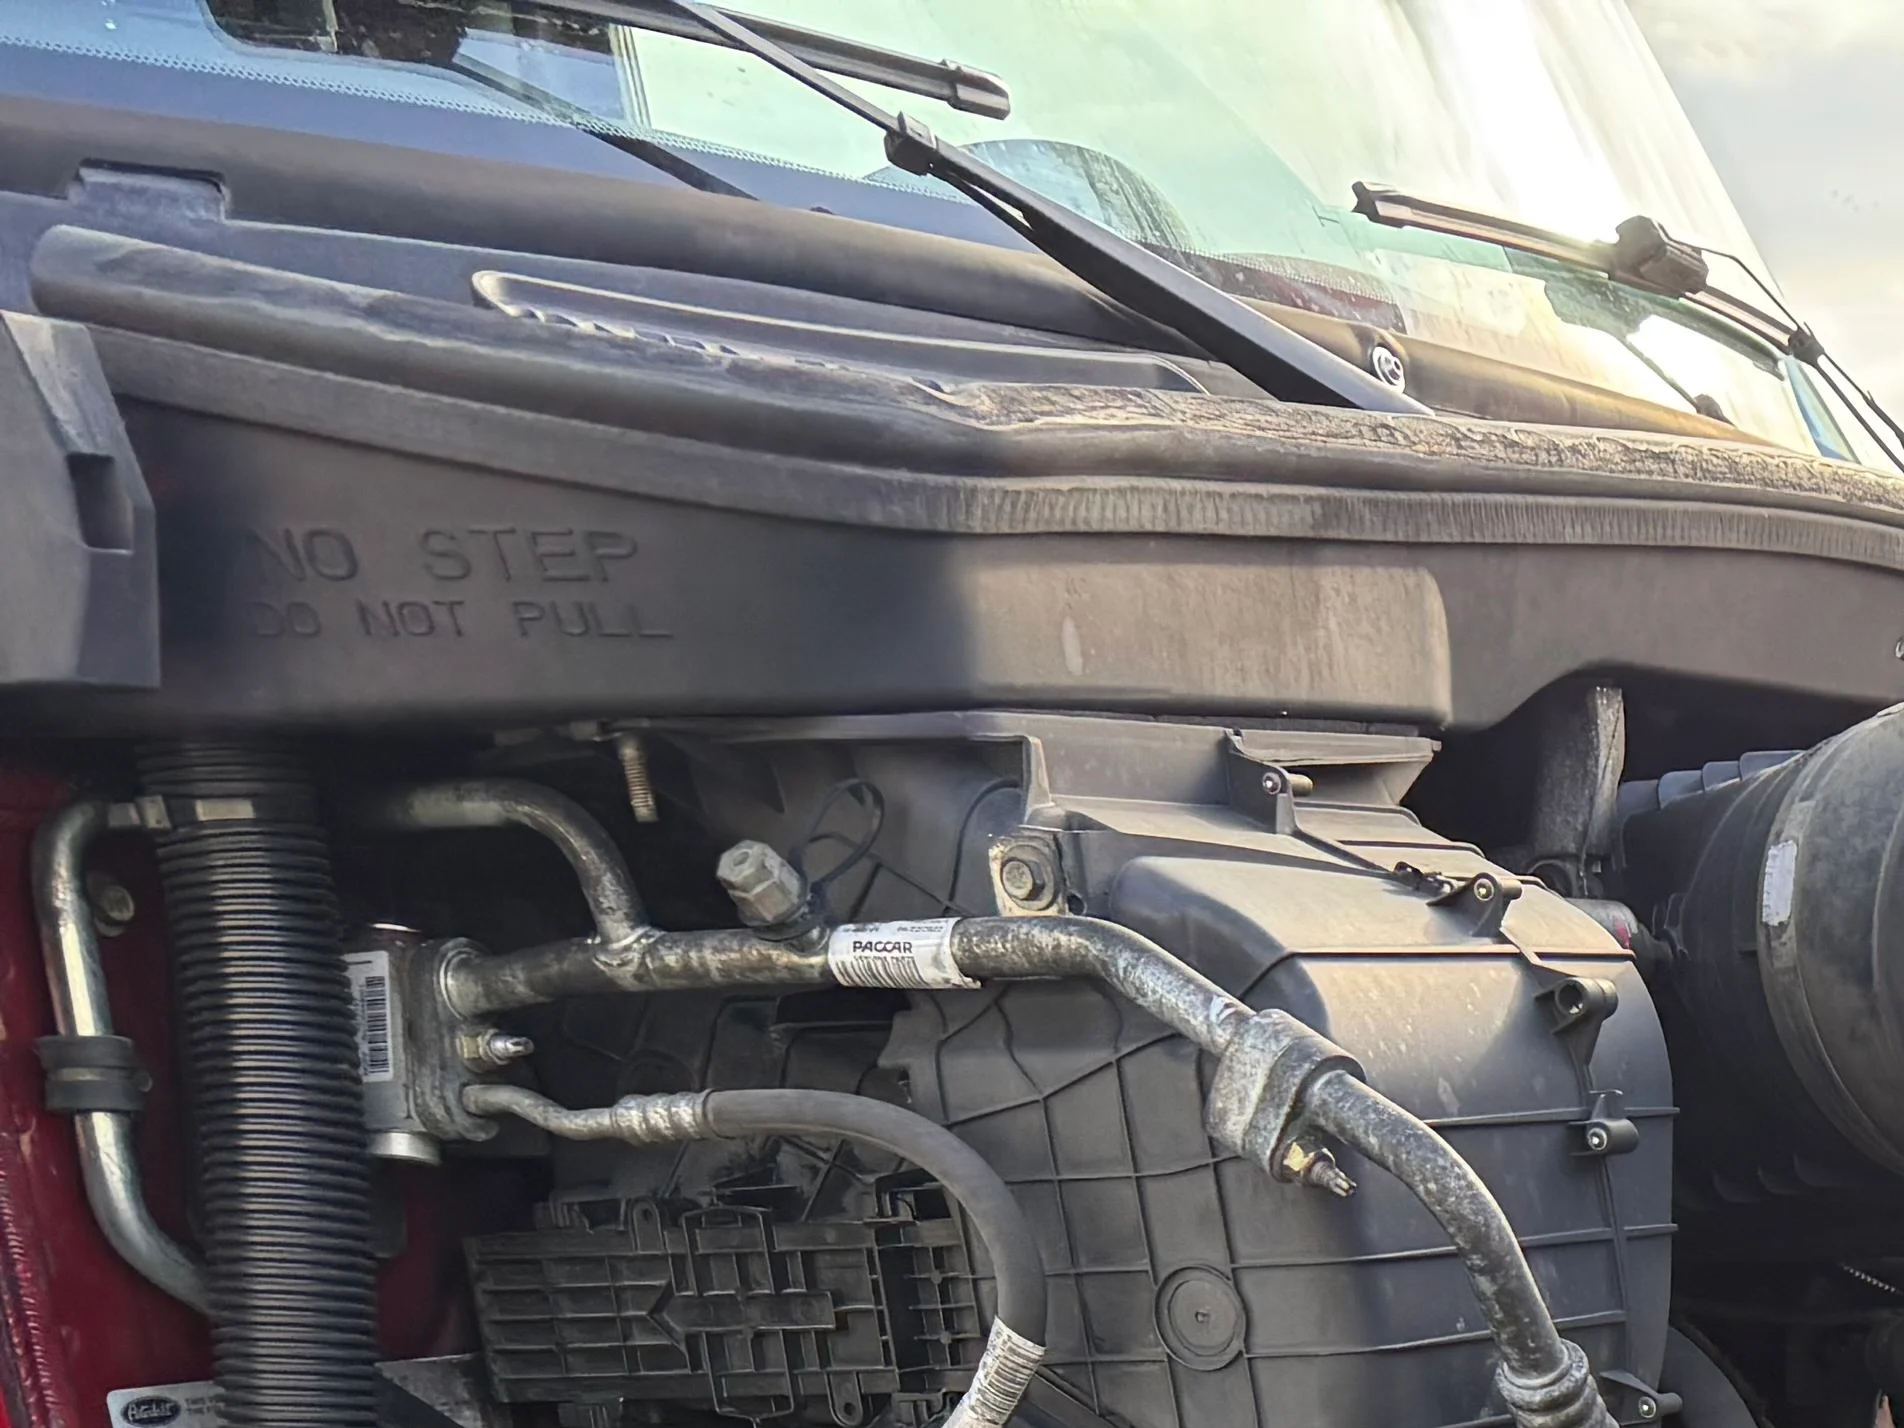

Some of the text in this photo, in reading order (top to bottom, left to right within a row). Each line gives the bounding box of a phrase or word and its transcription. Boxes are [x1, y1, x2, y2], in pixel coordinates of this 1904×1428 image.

[250, 525, 638, 583] NO STEP
[252, 599, 674, 639] DO NOT PULL
[853, 941, 912, 953] PACCAR
